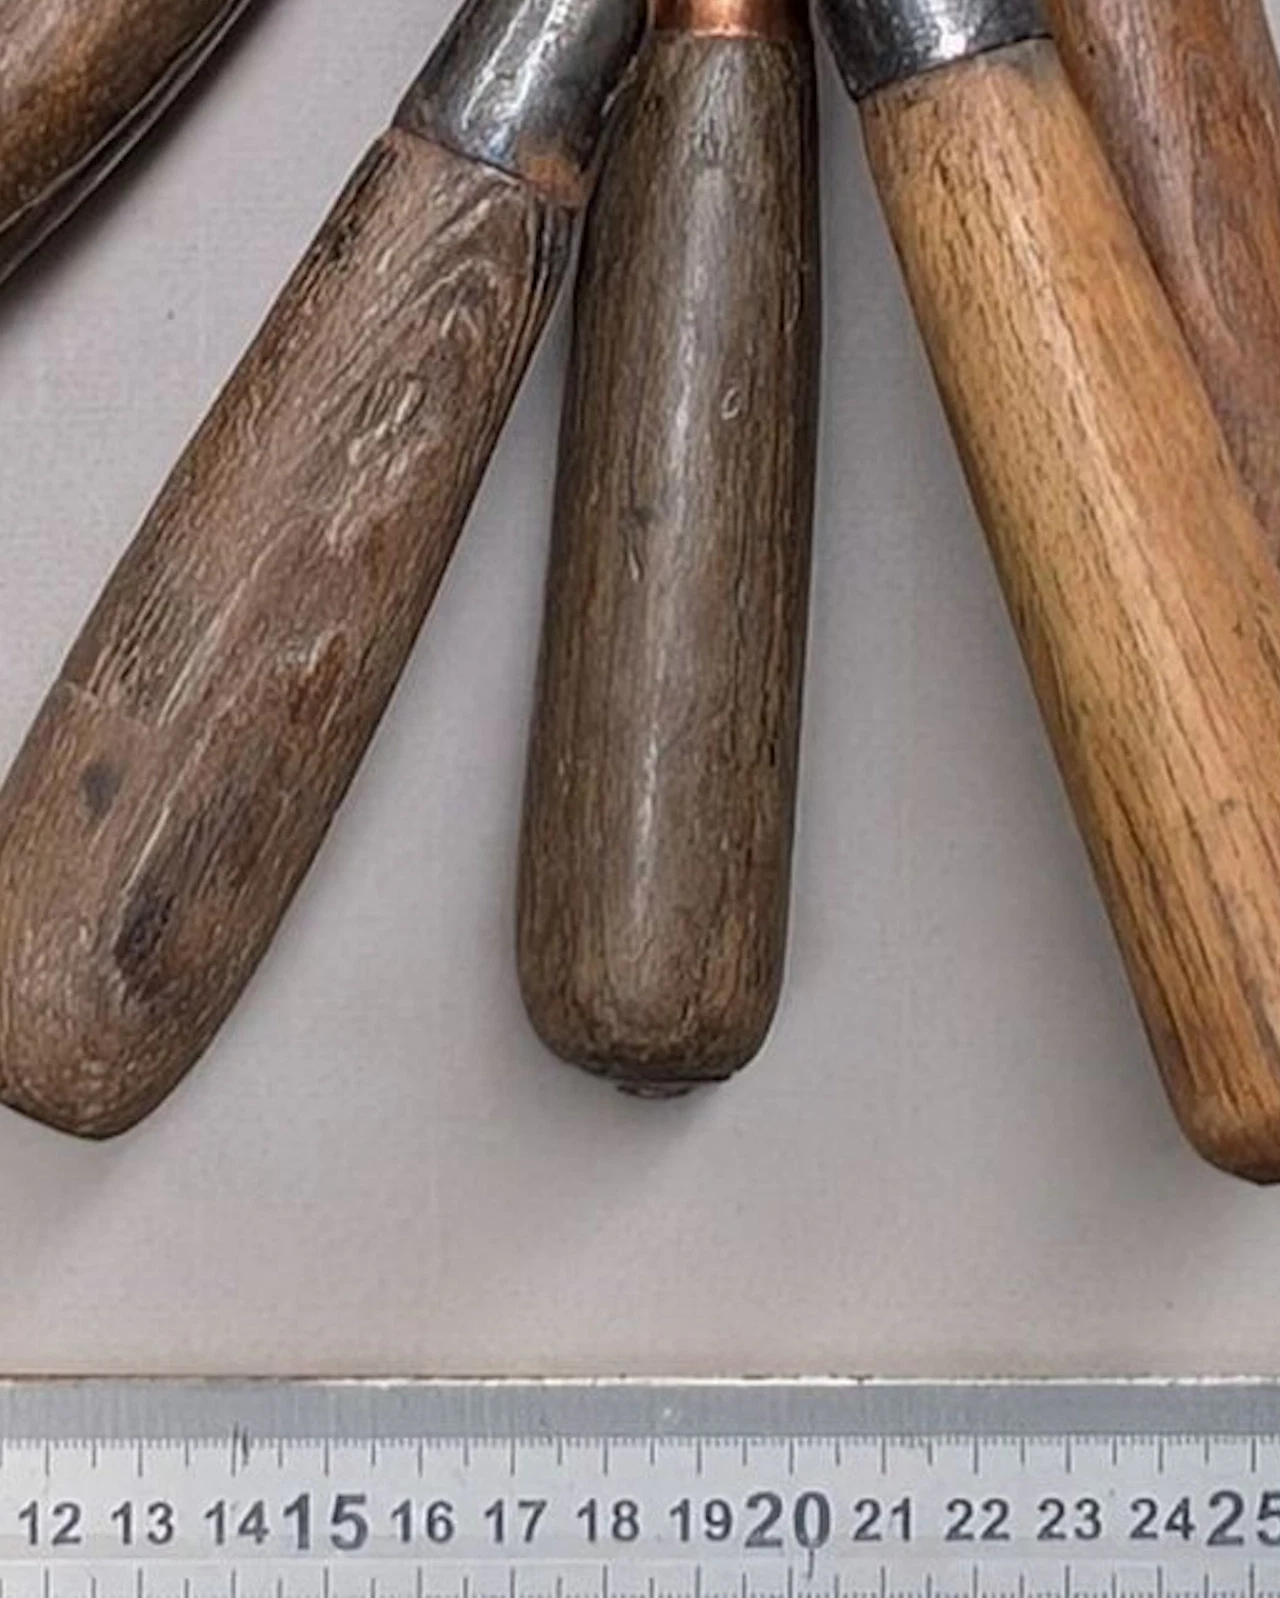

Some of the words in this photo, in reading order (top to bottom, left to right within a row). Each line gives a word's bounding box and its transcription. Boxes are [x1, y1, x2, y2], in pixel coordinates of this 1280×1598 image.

[18, 1500, 82, 1547] 12
[111, 1501, 174, 1546] 13
[204, 1499, 270, 1546] 14
[283, 1492, 369, 1551] 15
[390, 1499, 455, 1545] 16
[484, 1498, 548, 1544] 17
[577, 1498, 640, 1544] 18
[669, 1498, 733, 1543] 19
[743, 1491, 831, 1551] 20
[852, 1497, 911, 1543] 21
[944, 1498, 1011, 1542] 22
[1036, 1497, 1102, 1541] 23
[1129, 1496, 1196, 1542] 24
